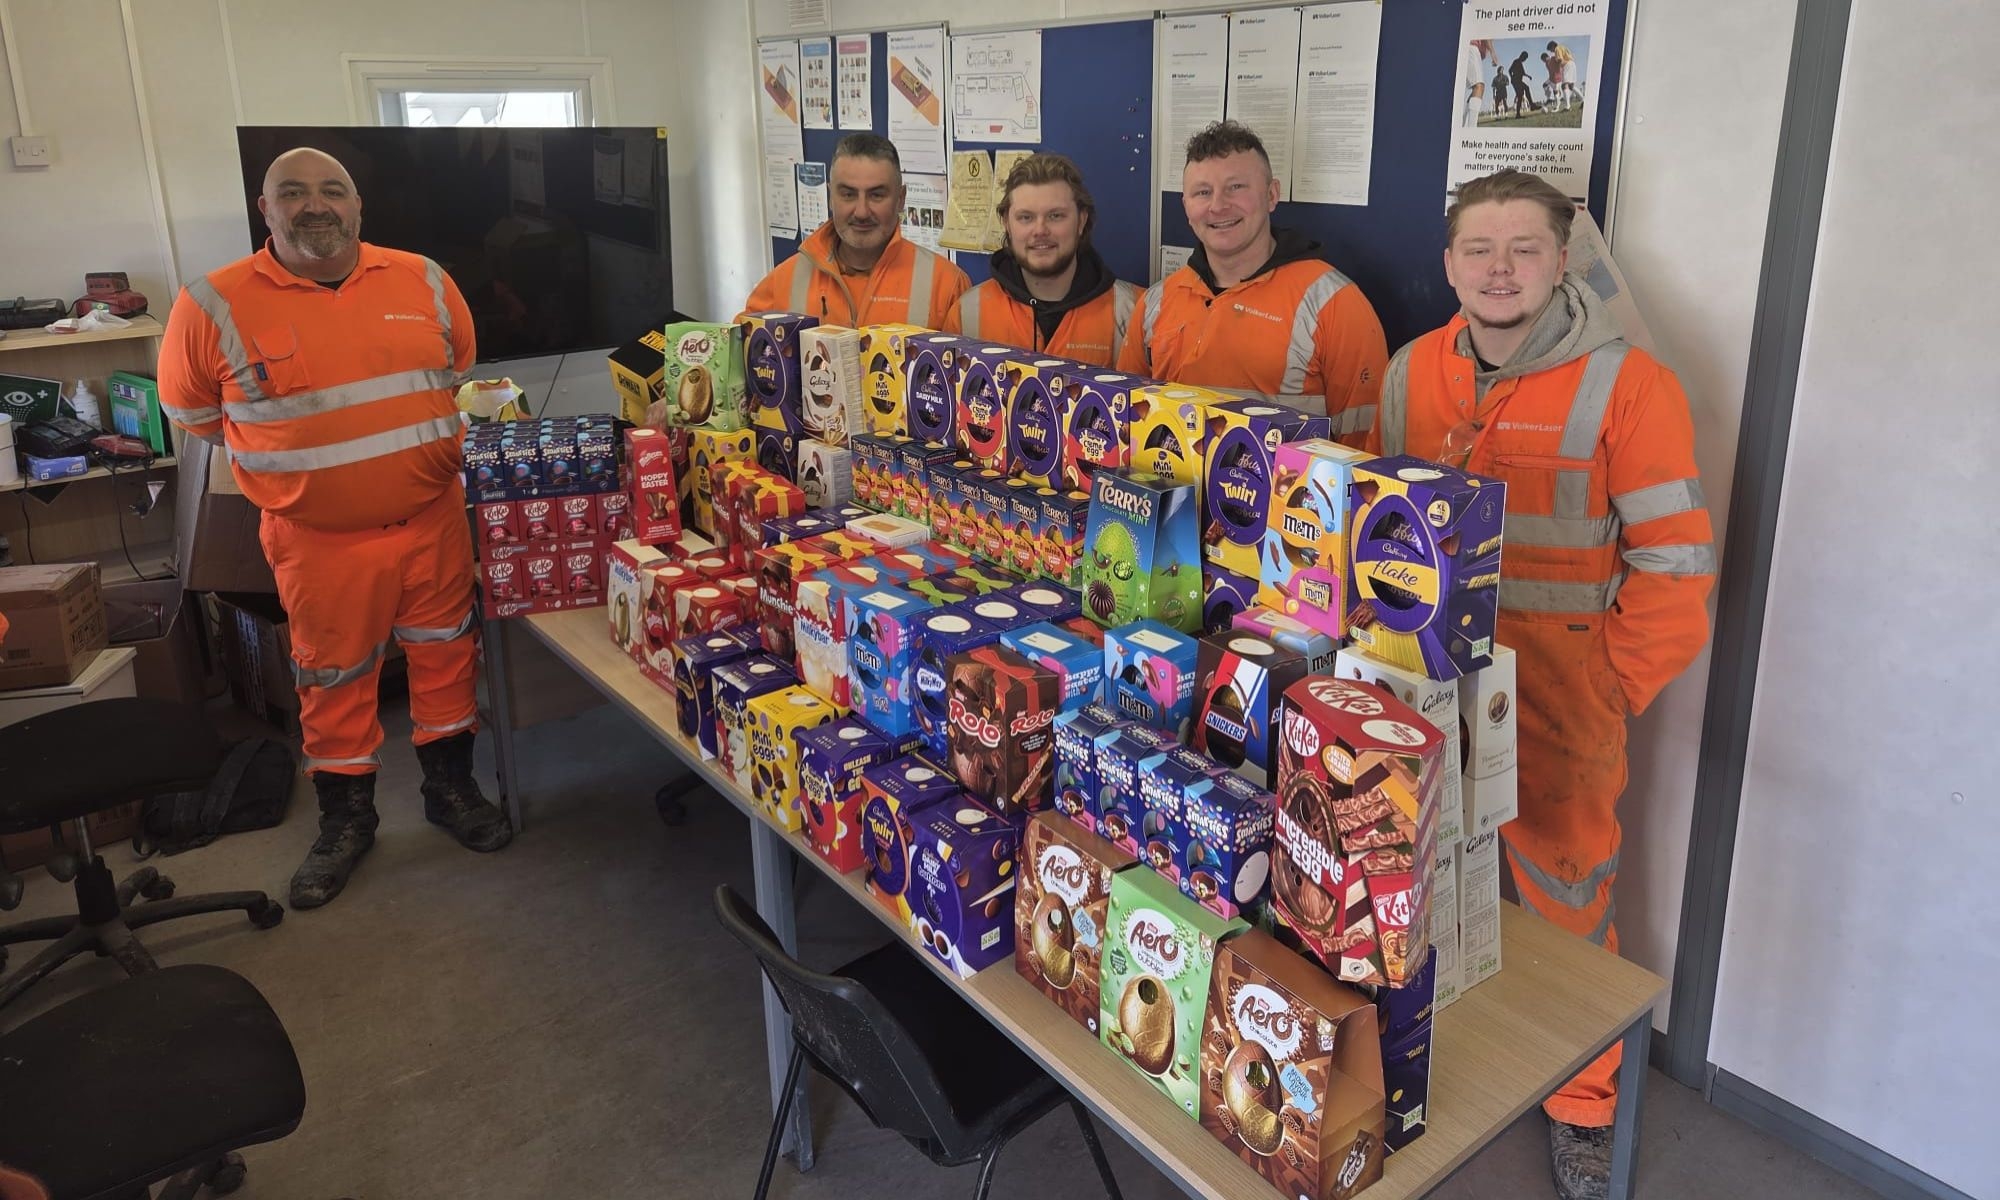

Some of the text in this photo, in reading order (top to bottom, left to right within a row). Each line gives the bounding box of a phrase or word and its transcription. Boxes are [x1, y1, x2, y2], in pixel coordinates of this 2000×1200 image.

[1475, 3, 1596, 20] The plant driver did not
[1507, 21, 1555, 32] see me...
[1461, 140, 1584, 152] Make health and safety count
[1475, 152, 1566, 163] for everyone's sake, it
[1464, 163, 1494, 171] matters
[1496, 164, 1504, 172] to
[1521, 165, 1538, 173] and
[1539, 165, 1548, 173] to
[1550, 165, 1575, 174] them.
[681, 339, 710, 356] Aero
[810, 375, 831, 389] Galaxy
[1017, 423, 1047, 444] Twirl
[1512, 421, 1563, 432] VolkerLaser
[1086, 447, 1100, 457] egg
[640, 472, 669, 482] HOPPY
[1153, 461, 1172, 472] Mini
[641, 479, 669, 489] EASTER
[1218, 481, 1257, 507] Twirl
[1437, 503, 1445, 512] XL
[1128, 512, 1150, 527] MINT
[1382, 543, 1408, 560] Cadbury
[1372, 560, 1418, 587] flake
[760, 588, 794, 614] Munchie
[800, 621, 830, 646] Milkybar
[1312, 650, 1337, 672] m&m
[1064, 665, 1100, 682] happy
[1064, 674, 1101, 690] easter
[1309, 681, 1381, 715] KitKat
[1422, 688, 1455, 713] Galaxy
[949, 698, 1001, 747] Rolo
[1010, 709, 1055, 737] Rolo
[1206, 713, 1246, 740] SNICKERS
[751, 729, 772, 747] Mini
[1288, 714, 1318, 755] KitKat
[752, 744, 776, 761] eggs
[1055, 734, 1089, 760] SMARTIES
[843, 754, 872, 772] UNLEASH
[1096, 757, 1133, 786] SMARTIES
[1140, 781, 1179, 811] SMARTIES
[867, 815, 895, 846] Twirl
[930, 823, 952, 838] EASTER
[936, 821, 957, 835] HAPPY
[1186, 808, 1229, 840] SMARTIES
[1235, 813, 1274, 844] SMARTIES
[1465, 829, 1496, 854] Galaxy
[921, 853, 941, 869] DAIRY
[923, 862, 940, 878] MILK
[1043, 854, 1084, 889] Aero
[1292, 843, 1322, 885] Egg
[1130, 920, 1179, 962] Aero
[1137, 952, 1165, 977] bubbles
[1238, 995, 1293, 1041] Aero
[1250, 1024, 1278, 1049] chocolate
